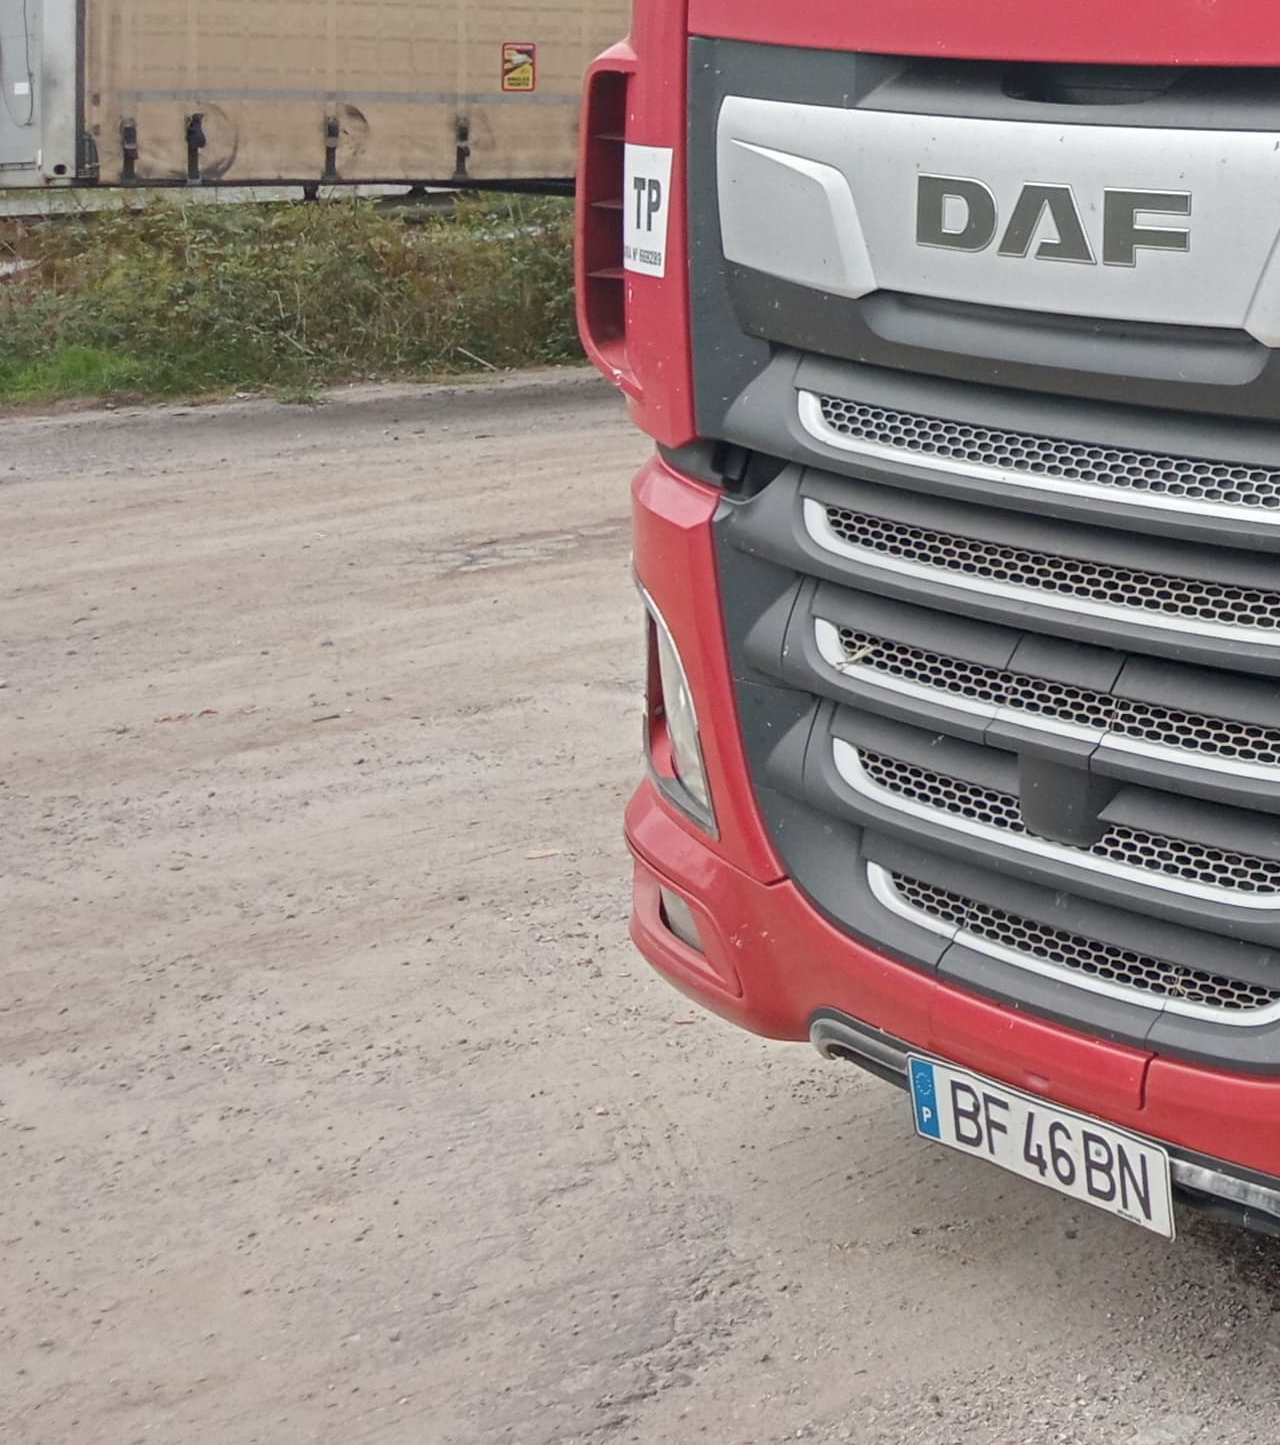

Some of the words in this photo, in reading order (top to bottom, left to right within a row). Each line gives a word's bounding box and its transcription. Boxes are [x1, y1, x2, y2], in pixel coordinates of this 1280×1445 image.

[633, 176, 662, 232] TP
[916, 171, 1192, 268] DAF
[921, 1106, 933, 1123] P
[950, 1079, 1009, 1155] BF
[1023, 1111, 1076, 1186] 46
[1082, 1129, 1152, 1221] BN
